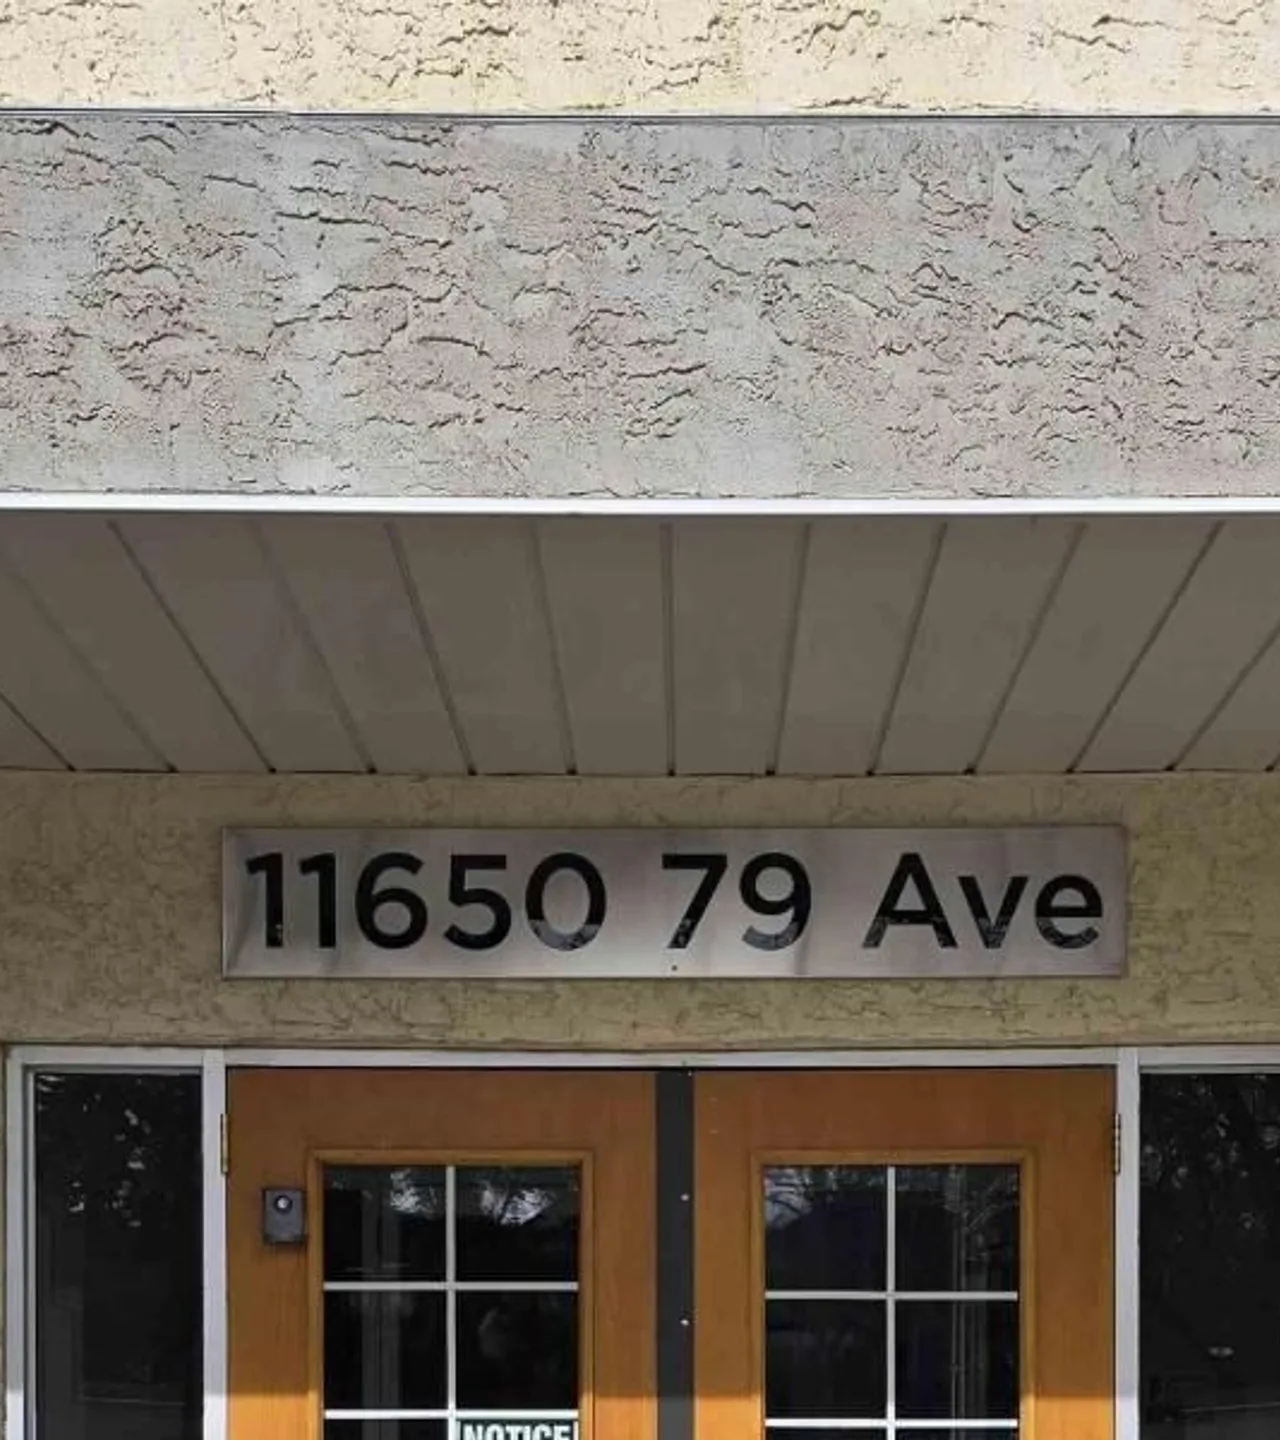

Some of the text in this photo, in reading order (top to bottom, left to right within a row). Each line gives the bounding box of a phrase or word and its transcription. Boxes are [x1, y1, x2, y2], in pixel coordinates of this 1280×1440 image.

[245, 851, 1104, 952] 11650 79 Ave
